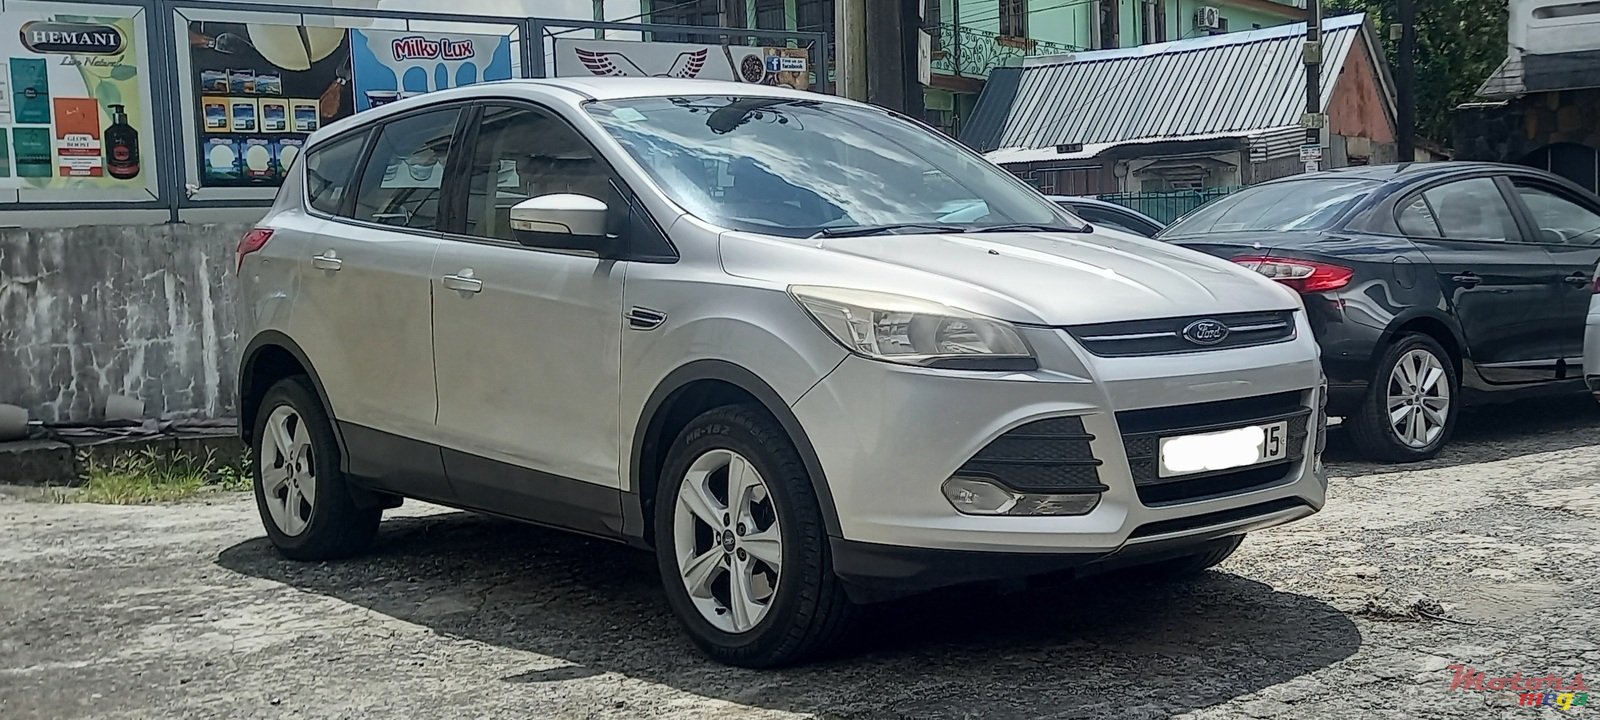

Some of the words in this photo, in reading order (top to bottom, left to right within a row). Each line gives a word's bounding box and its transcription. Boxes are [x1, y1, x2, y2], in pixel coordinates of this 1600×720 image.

[32, 30, 117, 46] HEMANI
[394, 38, 439, 60] Milky
[441, 39, 474, 60] Lux
[1196, 322, 1221, 339] Ford
[1263, 426, 1280, 458] 15
